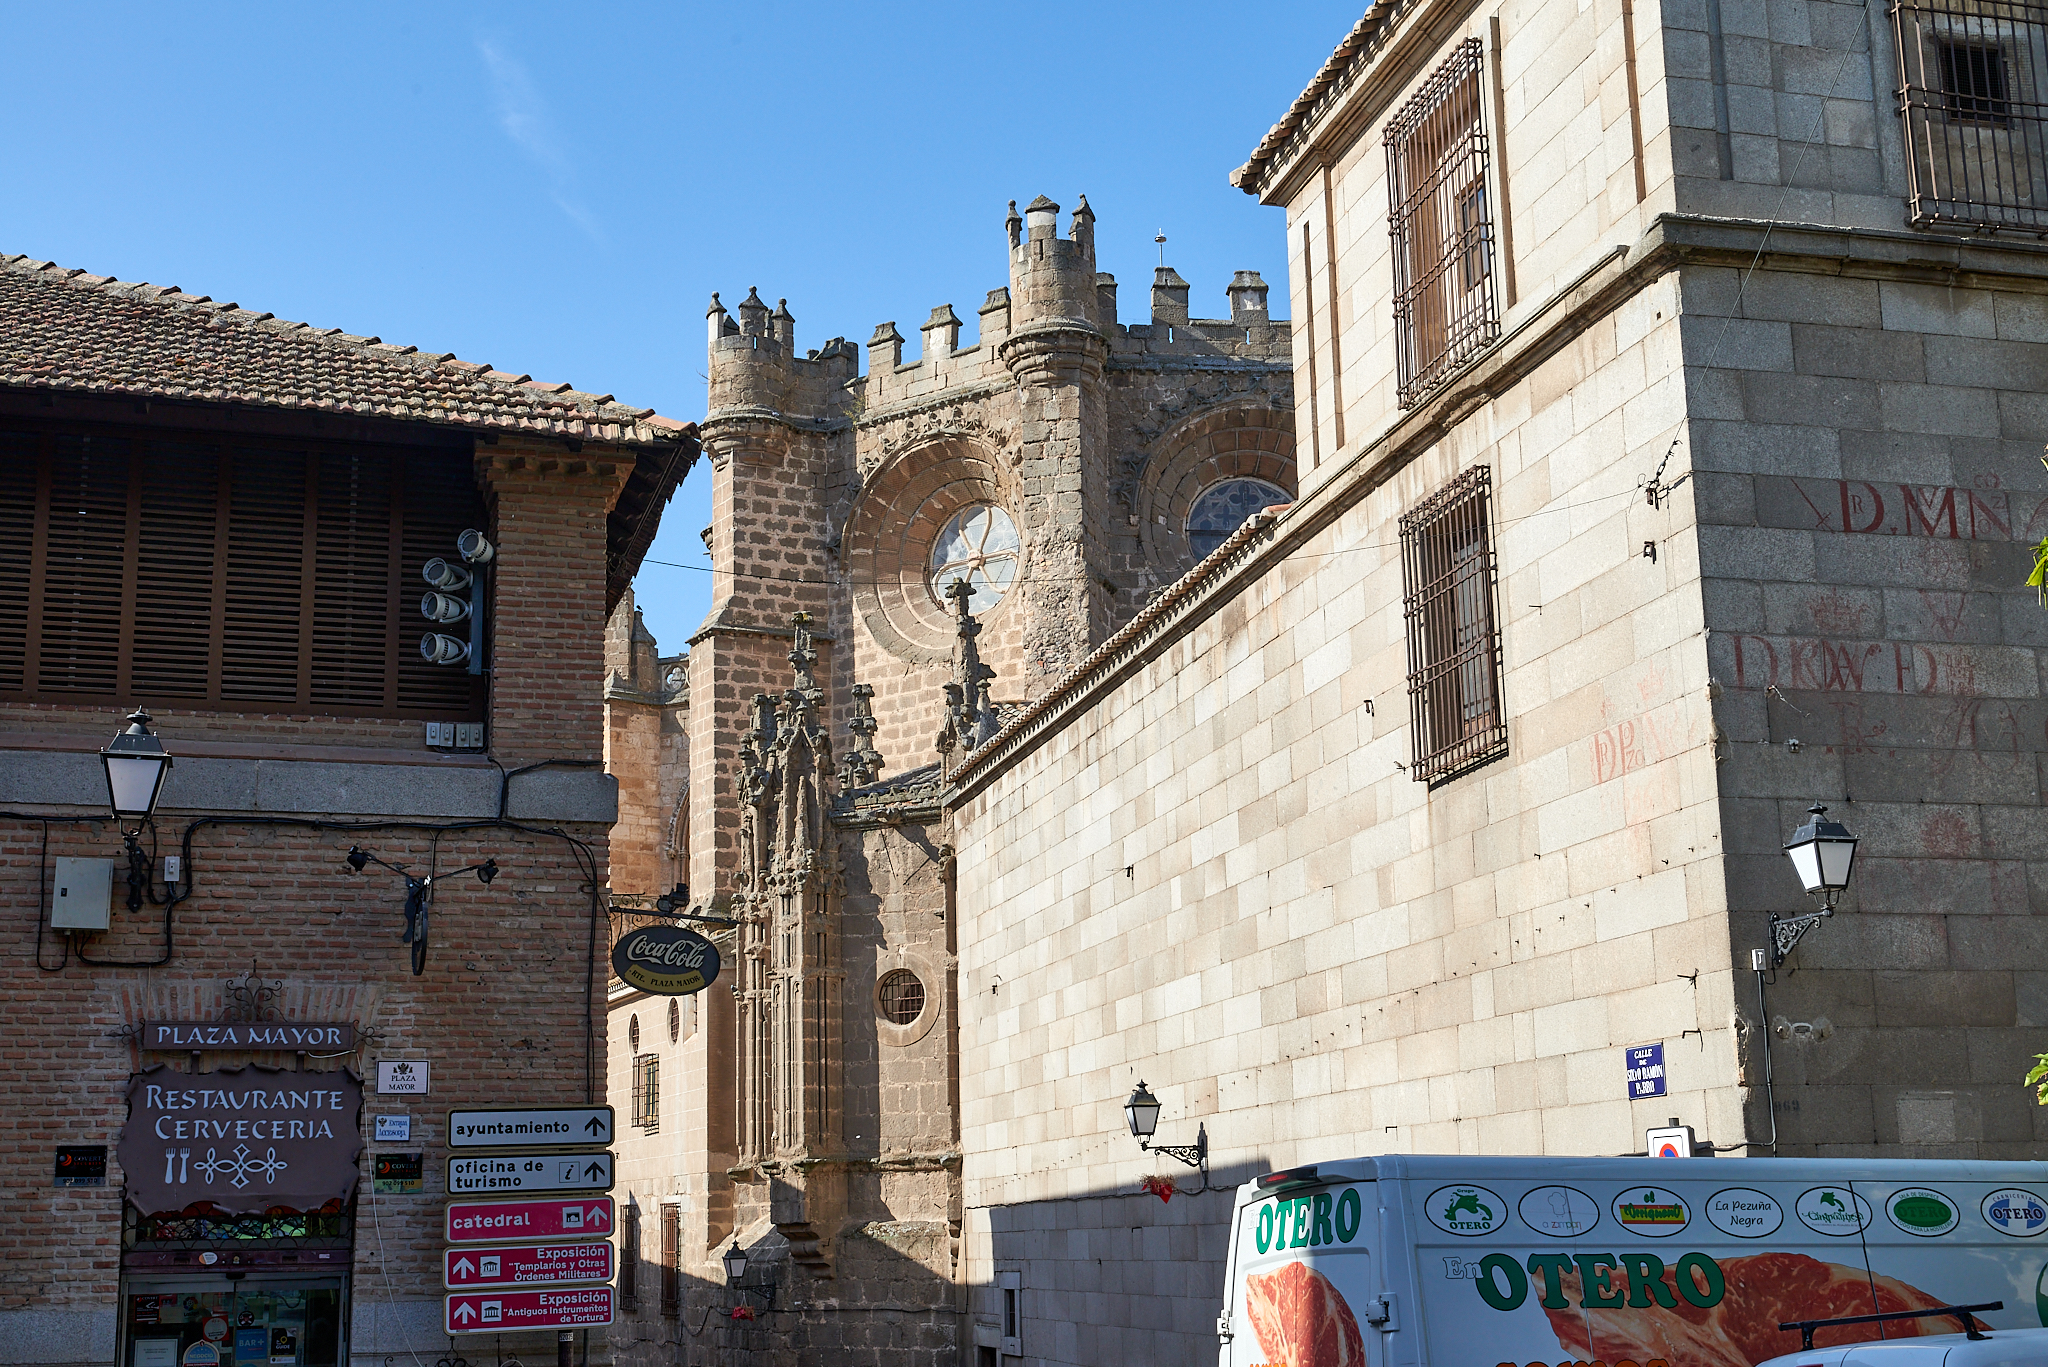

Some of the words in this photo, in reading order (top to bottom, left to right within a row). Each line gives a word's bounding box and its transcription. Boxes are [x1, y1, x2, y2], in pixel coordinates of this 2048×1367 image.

[626, 934, 709, 969] Coca-Cola
[650, 978, 674, 987] PLAZA
[157, 1027, 239, 1045] PLAZA
[248, 1027, 341, 1045] MAYOR
[1634, 1049, 1652, 1059] CALLE
[146, 1084, 344, 1110] RESTAURANTE
[154, 1115, 334, 1140] CERVECERIA
[456, 1121, 570, 1137] ayuntamiento
[455, 1161, 516, 1173] oficina
[523, 1160, 544, 1172] de
[455, 1176, 521, 1189] turismo
[1898, 1192, 1910, 1200] SALA
[1918, 1191, 1939, 1200] DESPIECE
[1992, 1193, 2037, 1203] CARNICERIAS
[1715, 1200, 1729, 1212] La
[1732, 1200, 1772, 1213] Pezuña
[1897, 1206, 1948, 1218] OTERO
[1993, 1208, 2043, 1219] OTERO
[453, 1212, 531, 1229] catedral
[1256, 1188, 1361, 1255] OTERO
[1449, 1221, 1491, 1230] OTERO
[1730, 1215, 1763, 1229] Negra
[537, 1245, 605, 1261] Exposición
[569, 1262, 576, 1270] y
[577, 1259, 606, 1269] Otras
[514, 1271, 555, 1281] Órdenes
[1443, 1256, 1484, 1280] En
[1475, 1252, 1725, 1311] OTERO
[540, 1291, 608, 1307] Exposición
[549, 1304, 608, 1315] Instrumentos
[560, 1314, 571, 1323] de
